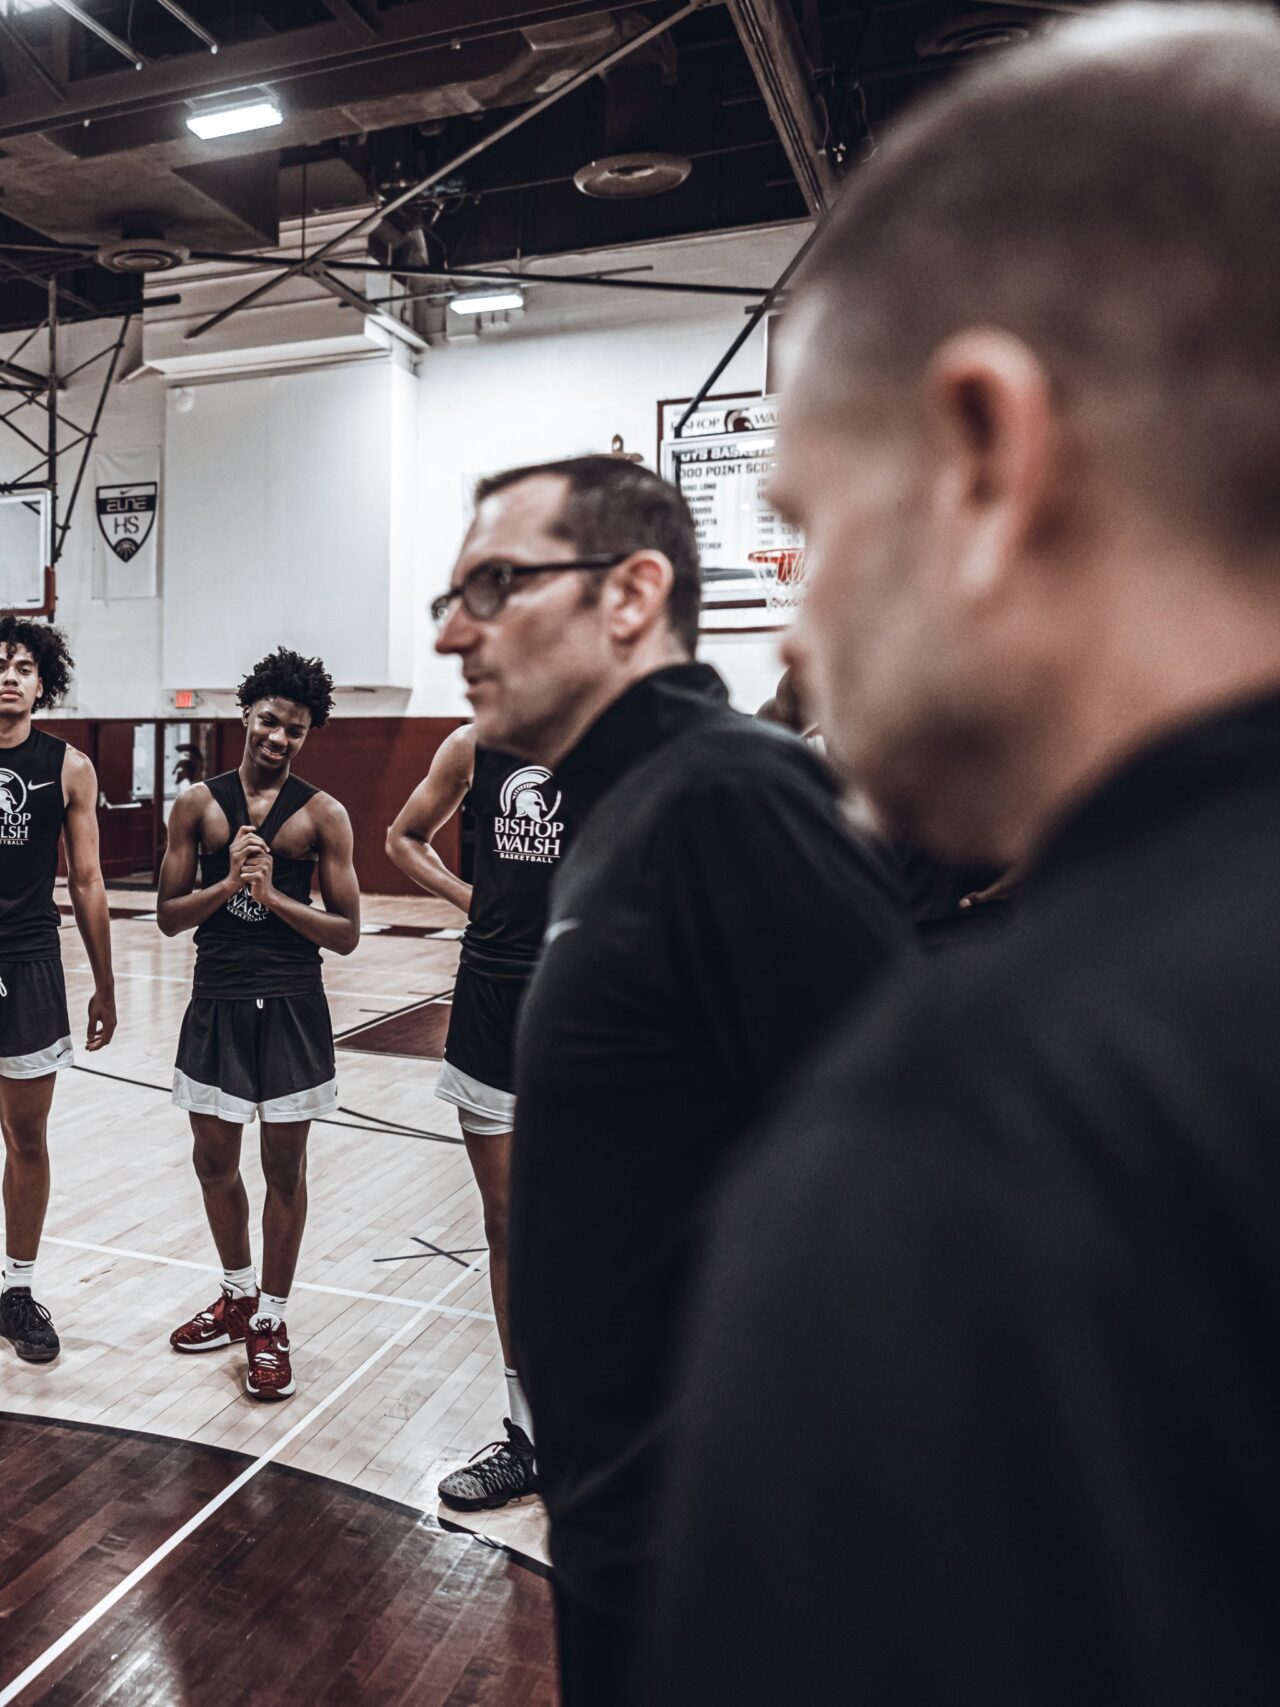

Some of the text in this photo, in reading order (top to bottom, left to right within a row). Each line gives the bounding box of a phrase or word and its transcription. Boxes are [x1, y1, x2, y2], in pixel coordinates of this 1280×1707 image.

[706, 464, 741, 477] POINT
[114, 516, 139, 534] HS
[494, 816, 565, 838] BISHOP
[495, 833, 561, 855] WALSH
[500, 852, 553, 863] BASKETBALL
